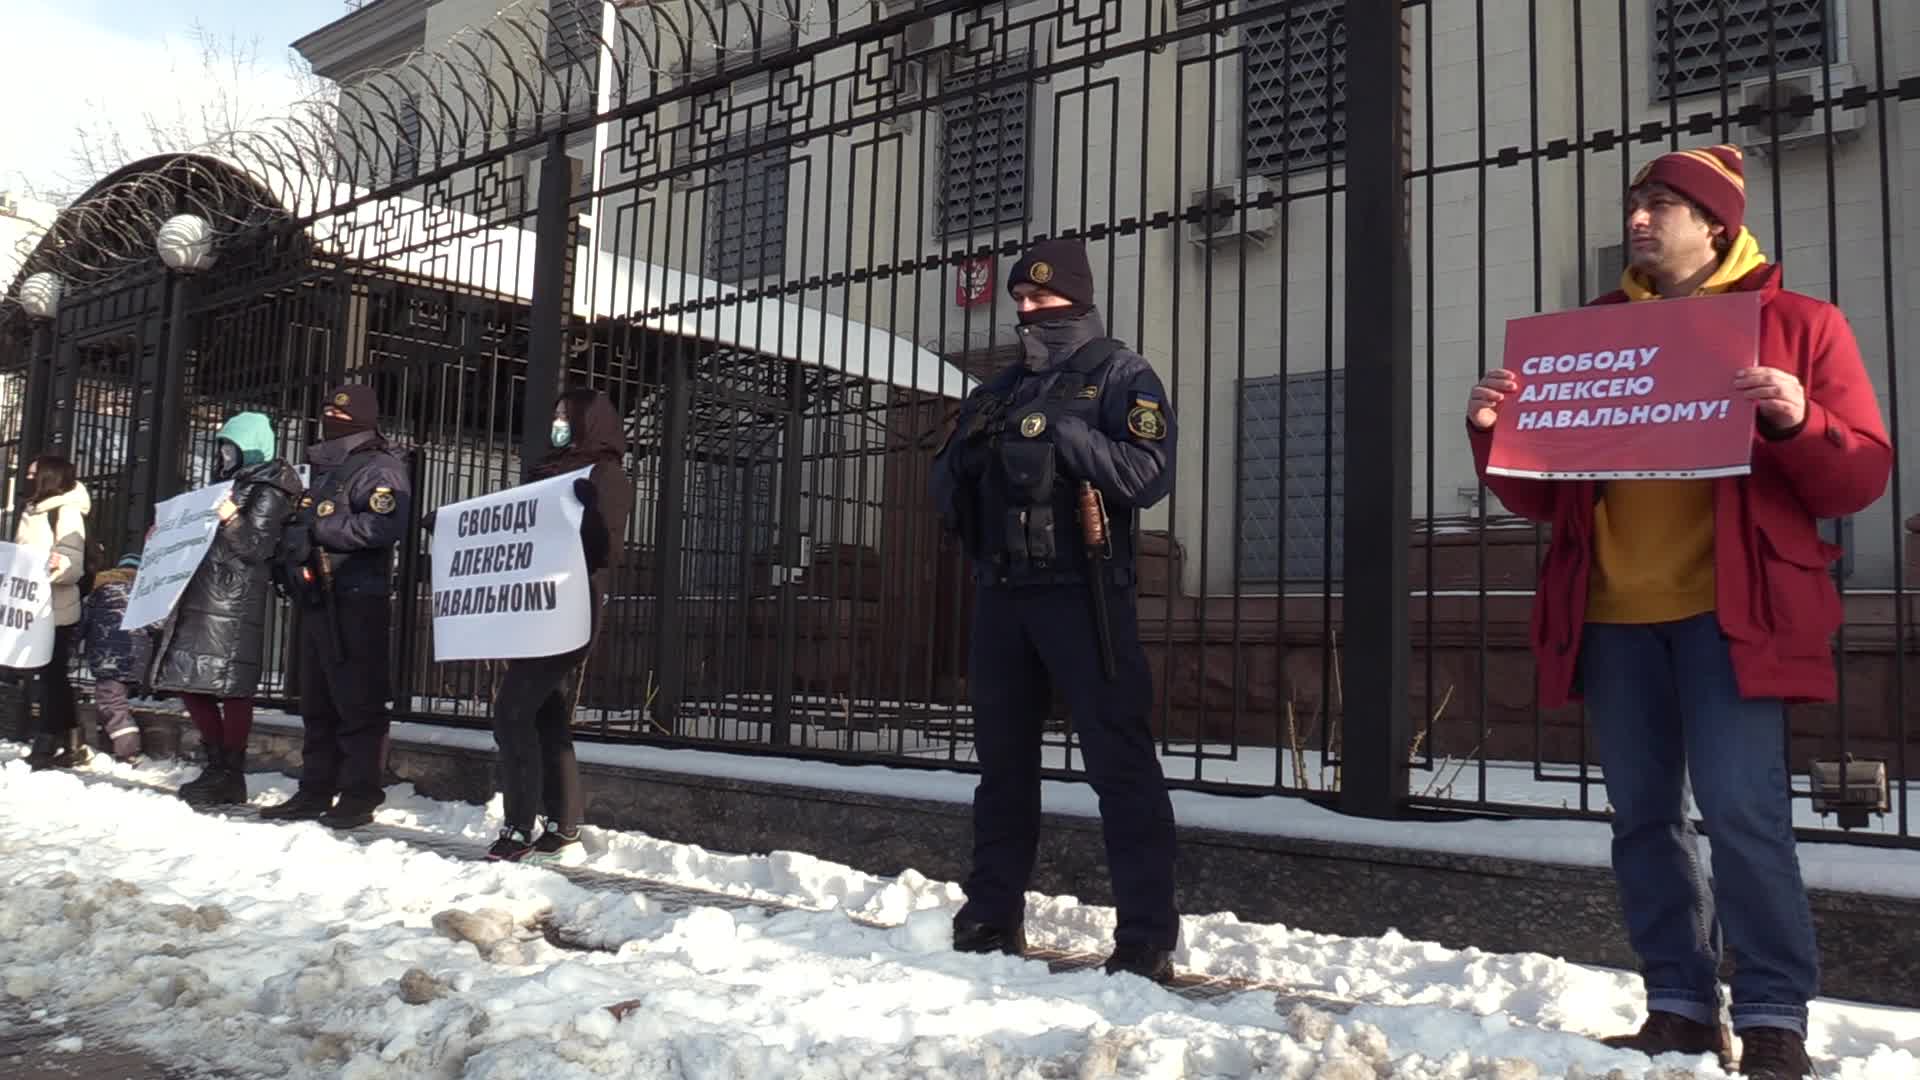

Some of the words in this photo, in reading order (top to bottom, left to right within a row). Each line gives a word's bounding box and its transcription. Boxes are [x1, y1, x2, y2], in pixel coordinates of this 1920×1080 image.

[1521, 347, 1660, 375] СВОБОДУ
[1518, 376, 1655, 403] АЛЕКСЕЮ
[1516, 400, 1731, 430] НАВАЛЬНОМУ!
[458, 499, 539, 538] СВОБОДУ
[448, 541, 534, 577] АЛЕКСЕЮ
[433, 580, 557, 618] НАВАЛЬНОМУ
